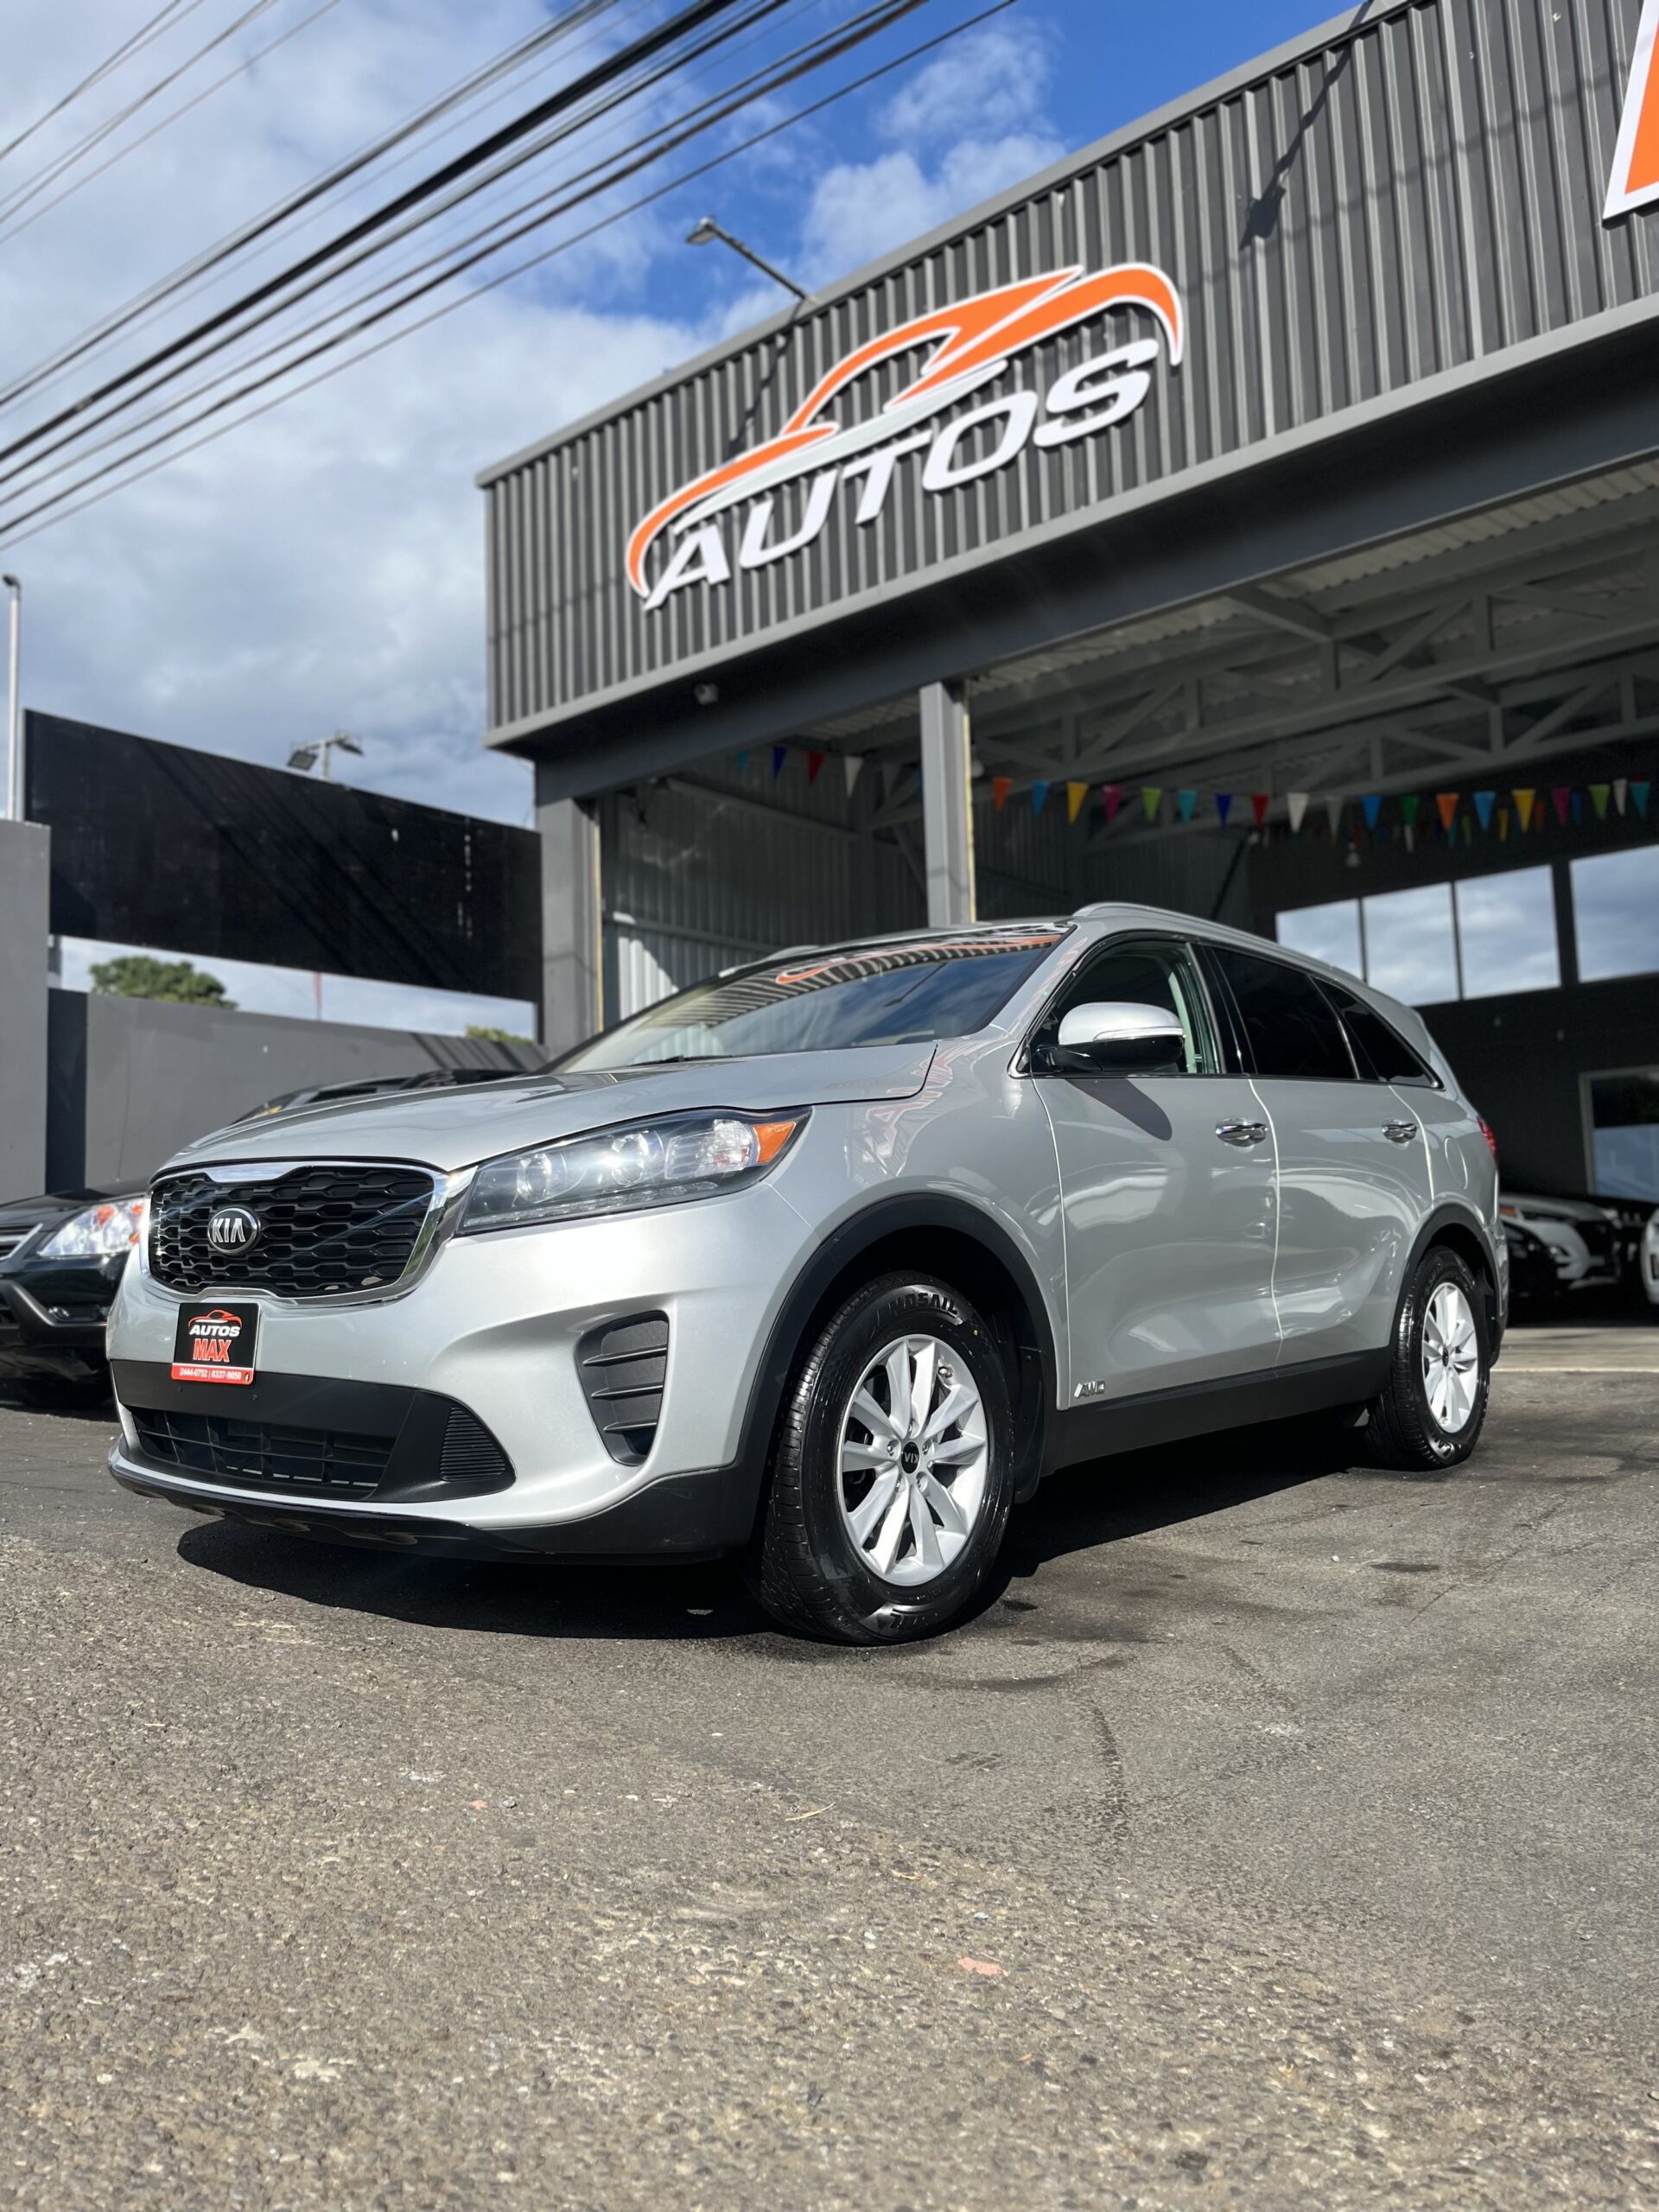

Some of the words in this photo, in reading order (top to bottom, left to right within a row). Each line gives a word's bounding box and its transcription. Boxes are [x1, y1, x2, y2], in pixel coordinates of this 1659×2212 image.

[643, 339, 1159, 610] AUTOS
[212, 1217, 246, 1243] KIA
[189, 1325, 241, 1337] AUTOS
[193, 1338, 232, 1362] MAX
